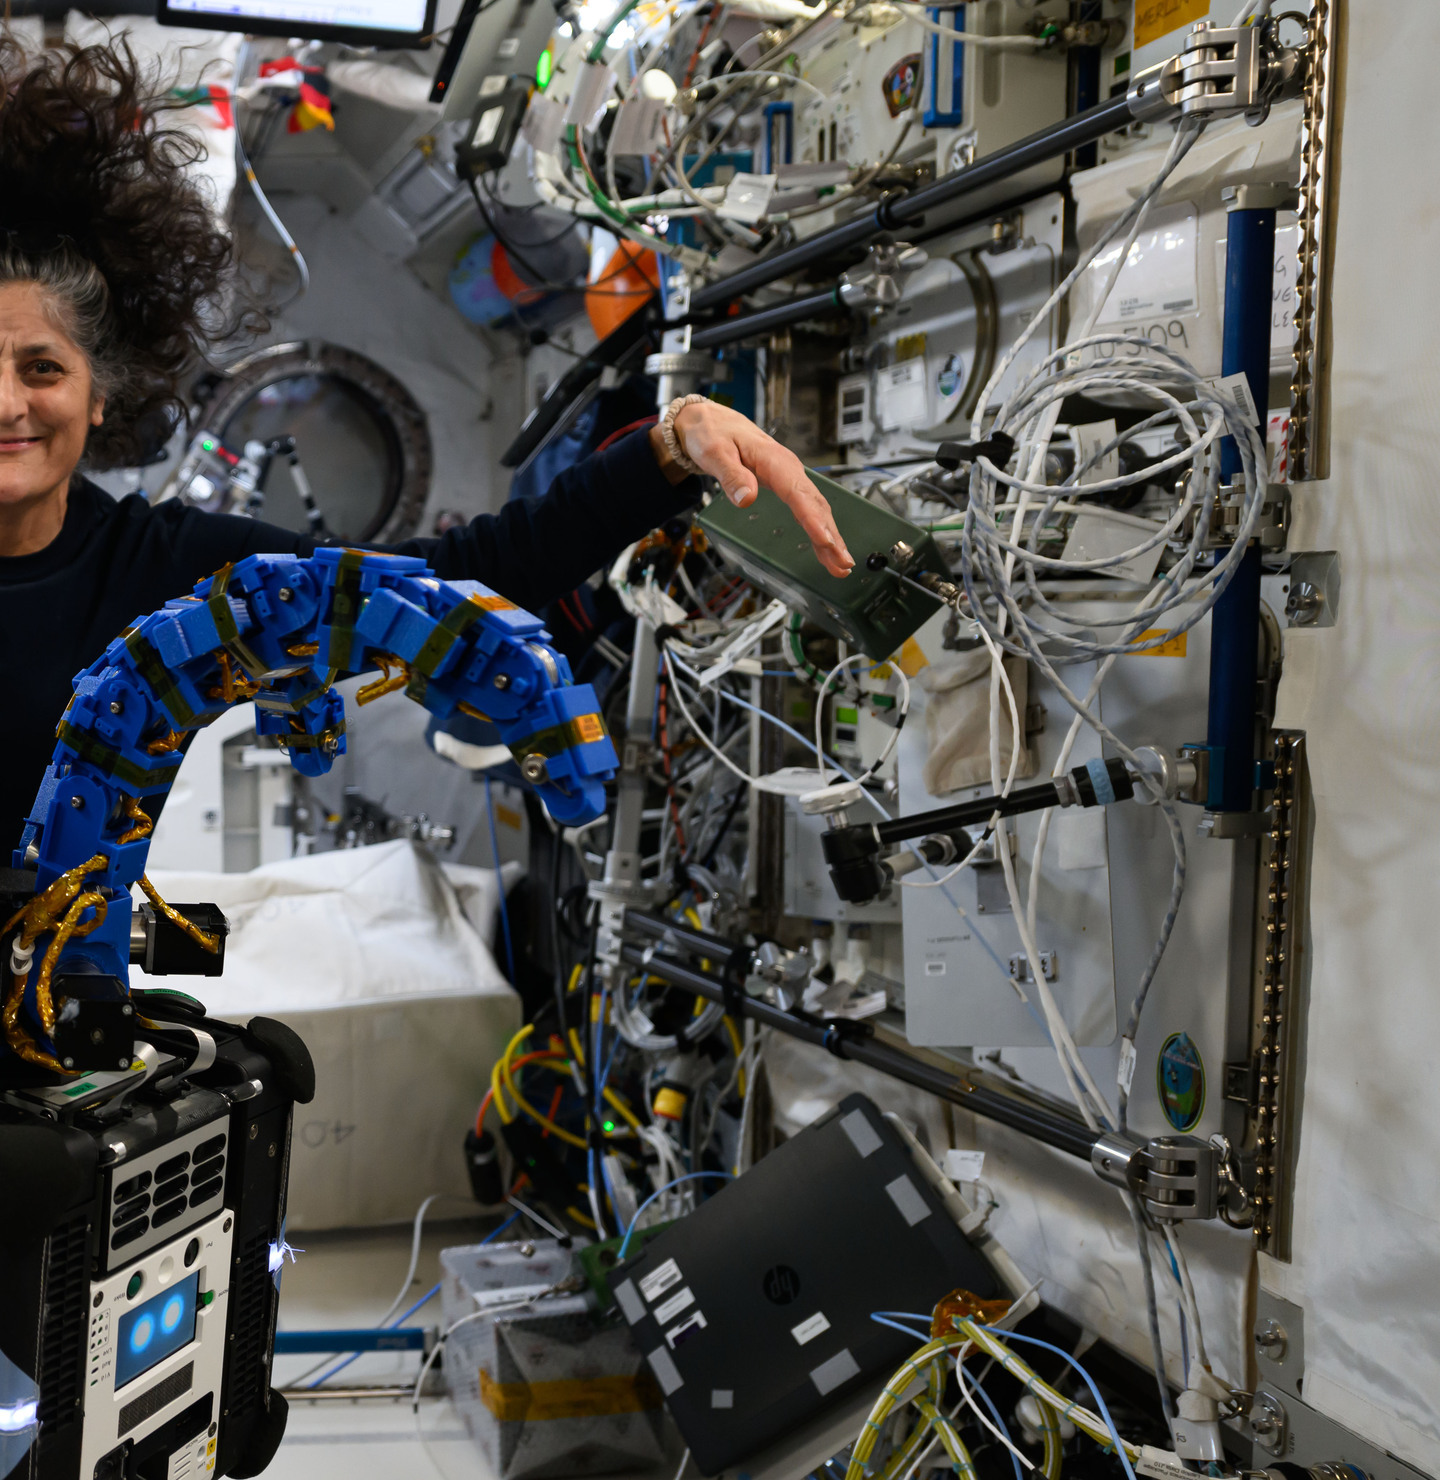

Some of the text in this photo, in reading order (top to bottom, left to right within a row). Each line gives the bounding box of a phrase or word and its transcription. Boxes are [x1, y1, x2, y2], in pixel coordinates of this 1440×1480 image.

[766, 1265, 799, 1304] hp
[102, 1346, 112, 1357] Live
[101, 1359, 111, 1368] Aud
[100, 1371, 110, 1381] Vid
[1176, 1432, 1187, 1443] J2
[1143, 1464, 1169, 1476] Package
[1154, 1461, 1166, 1470] J10
[1166, 1465, 1180, 1474] Data
